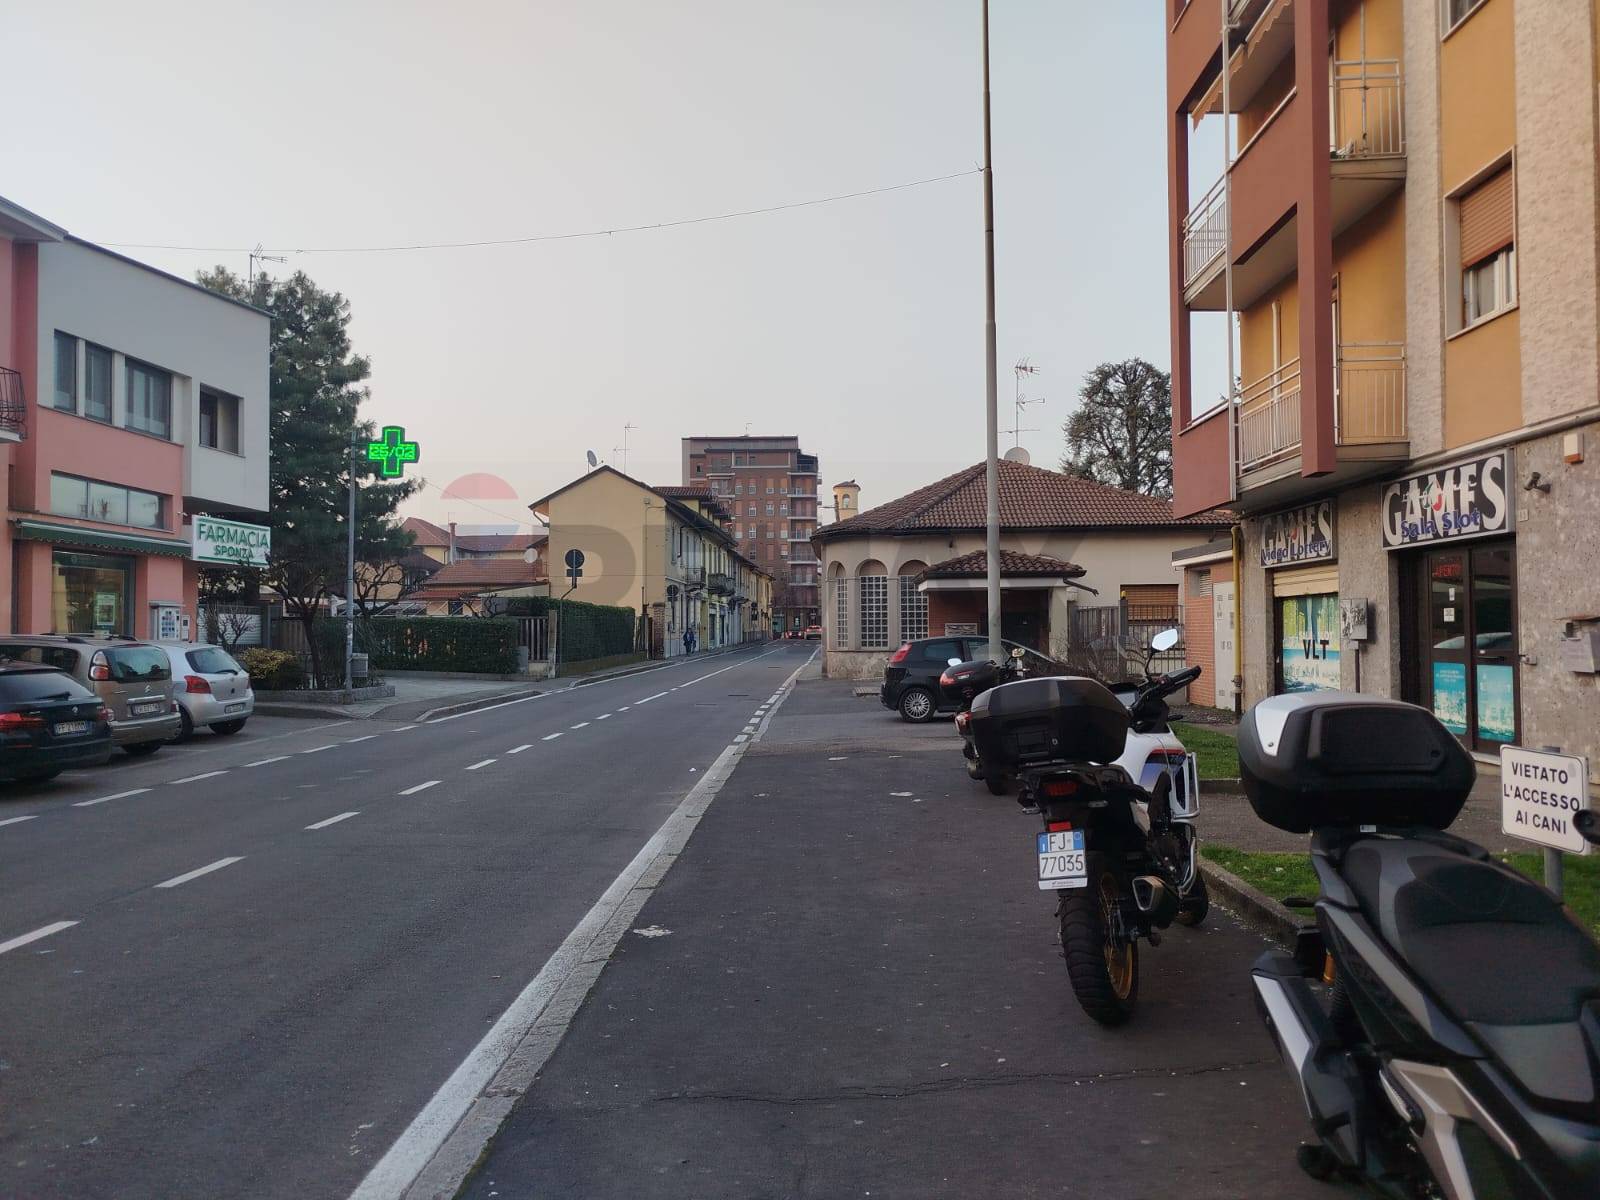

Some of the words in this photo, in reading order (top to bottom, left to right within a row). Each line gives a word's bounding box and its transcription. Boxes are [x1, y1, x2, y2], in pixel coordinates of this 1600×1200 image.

[369, 446, 415, 457] 25/02
[1382, 456, 1505, 546] GAMES
[1261, 502, 1331, 566] GAMES
[1401, 516, 1435, 538] Sala
[1442, 508, 1480, 531] Slot
[199, 523, 269, 548] FARMACIA
[215, 545, 254, 558] SPONZA
[1290, 540, 1331, 557] Lottery
[1303, 640, 1330, 660] VLT
[1511, 761, 1568, 784] VIETATO
[1504, 783, 1580, 812] L'ACCESSO
[1516, 810, 1528, 825] AI
[1532, 814, 1567, 835] CANI
[1049, 833, 1066, 851] FJ
[1041, 854, 1083, 874] 77035
